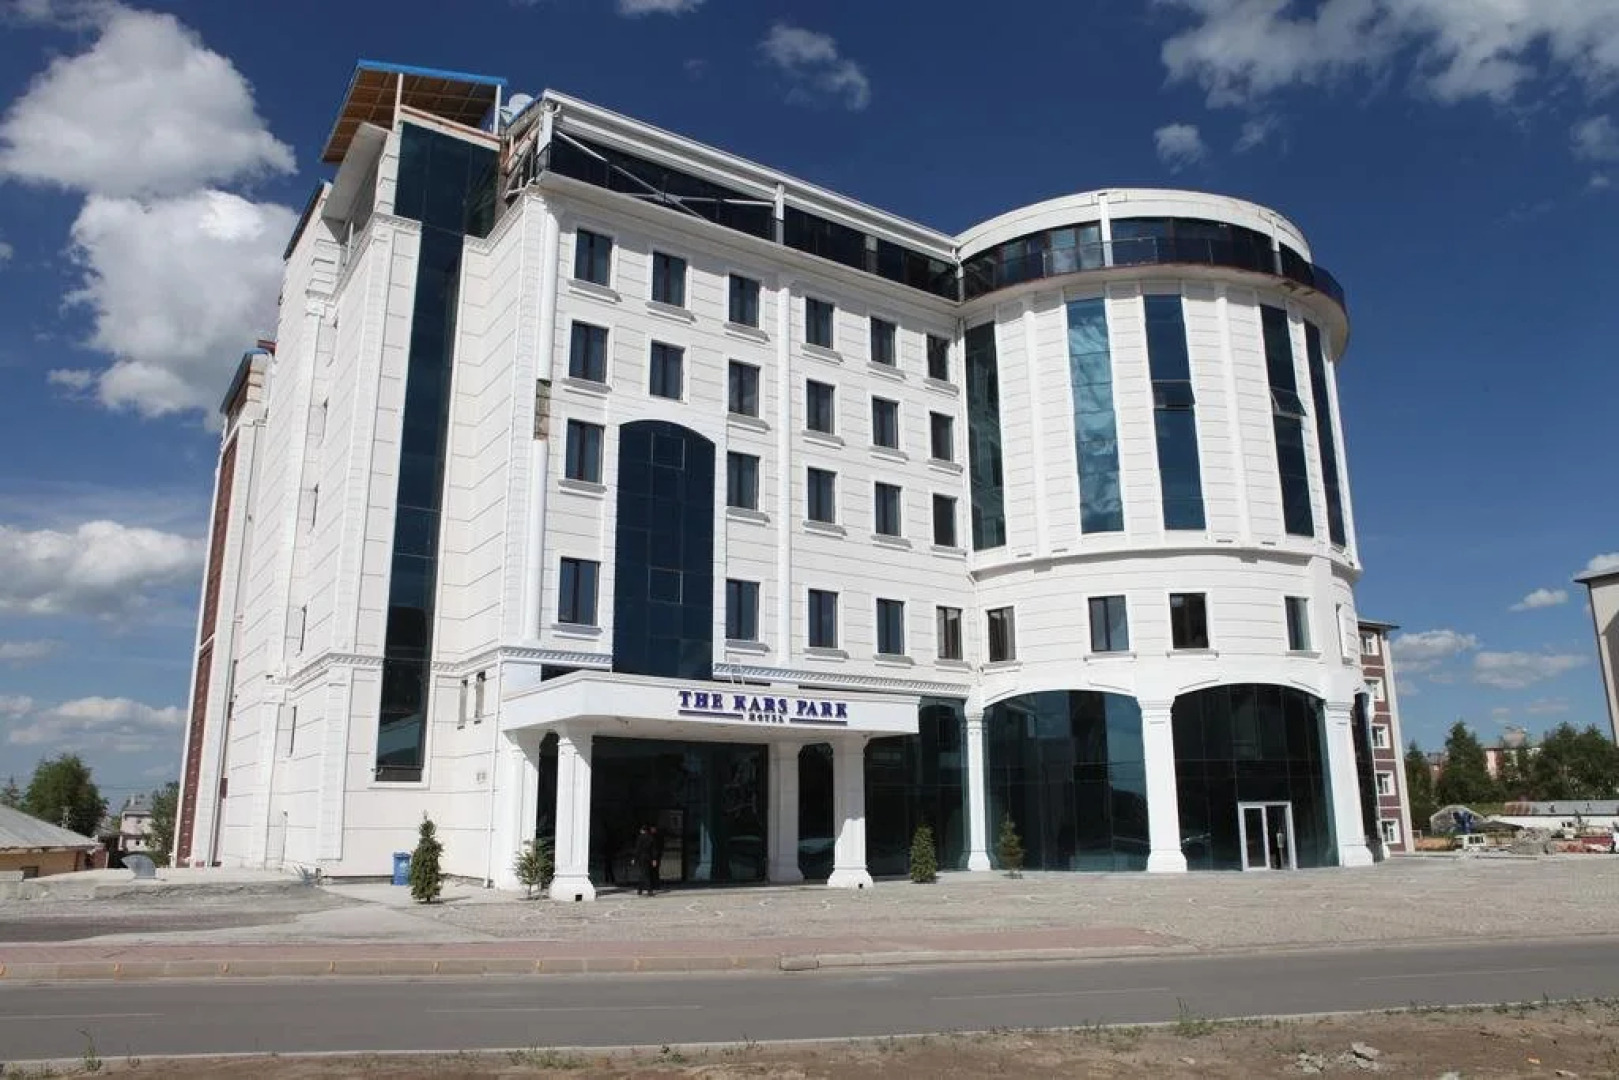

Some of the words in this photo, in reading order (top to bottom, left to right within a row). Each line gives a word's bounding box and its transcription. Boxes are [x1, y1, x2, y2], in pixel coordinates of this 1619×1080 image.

[678, 690, 723, 709] THE
[733, 695, 788, 715] KARS
[796, 700, 848, 719] PARK
